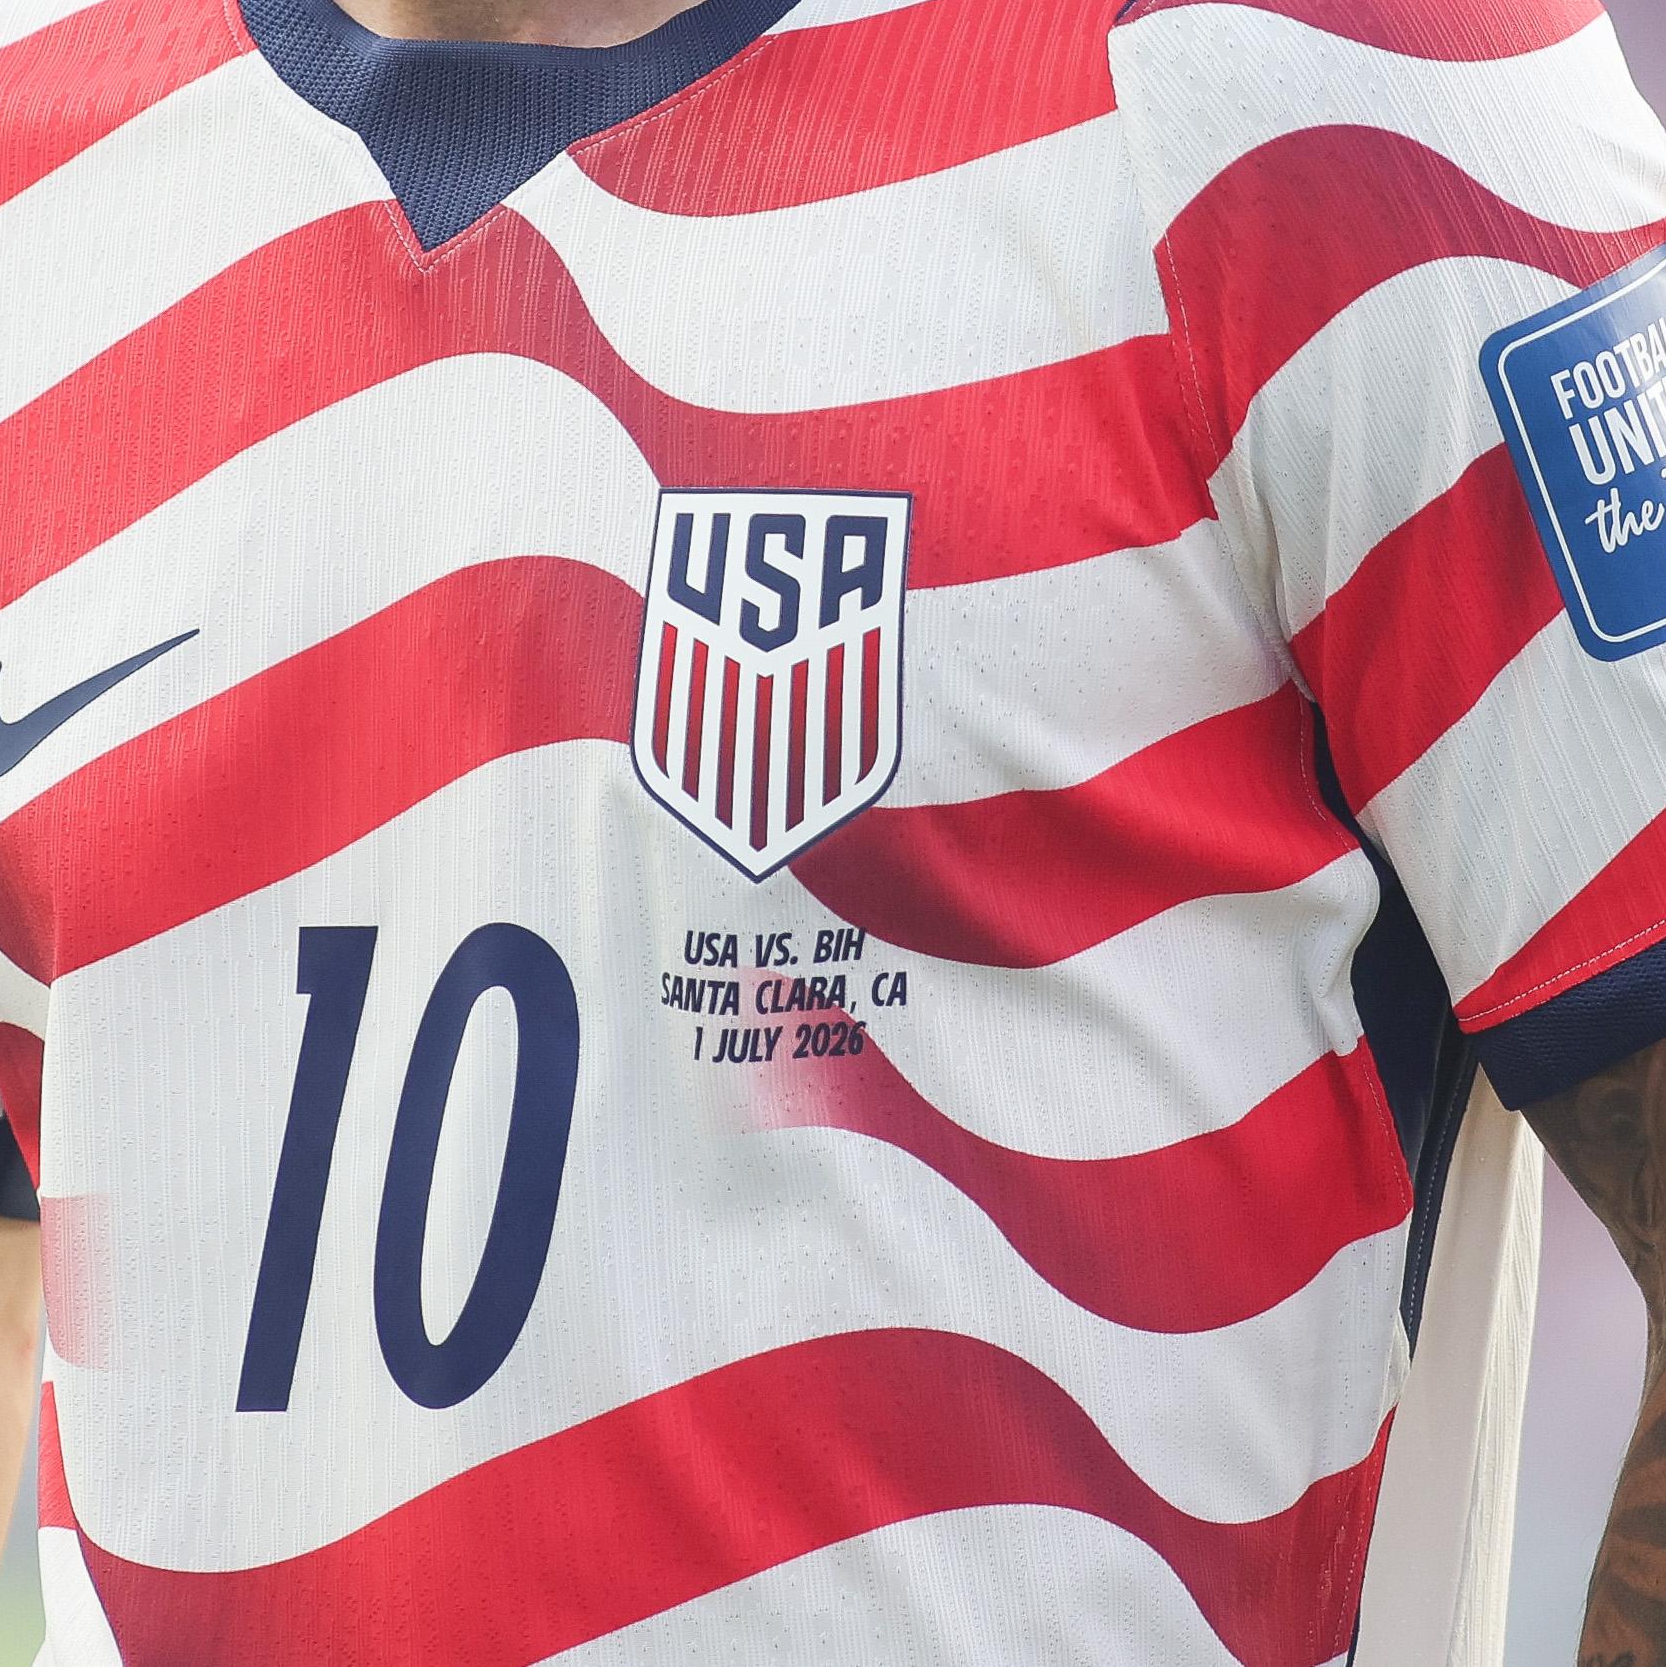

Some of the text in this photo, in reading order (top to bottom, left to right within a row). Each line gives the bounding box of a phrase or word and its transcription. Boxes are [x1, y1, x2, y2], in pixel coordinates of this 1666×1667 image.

[1585, 487, 1665, 553] the
[667, 512, 889, 653] USA
[684, 927, 866, 968] USA VS. BIH
[661, 971, 908, 1016] SANTA CLARA, CA
[694, 1021, 867, 1064] 1 JULY 2026
[235, 922, 580, 1413] 10
